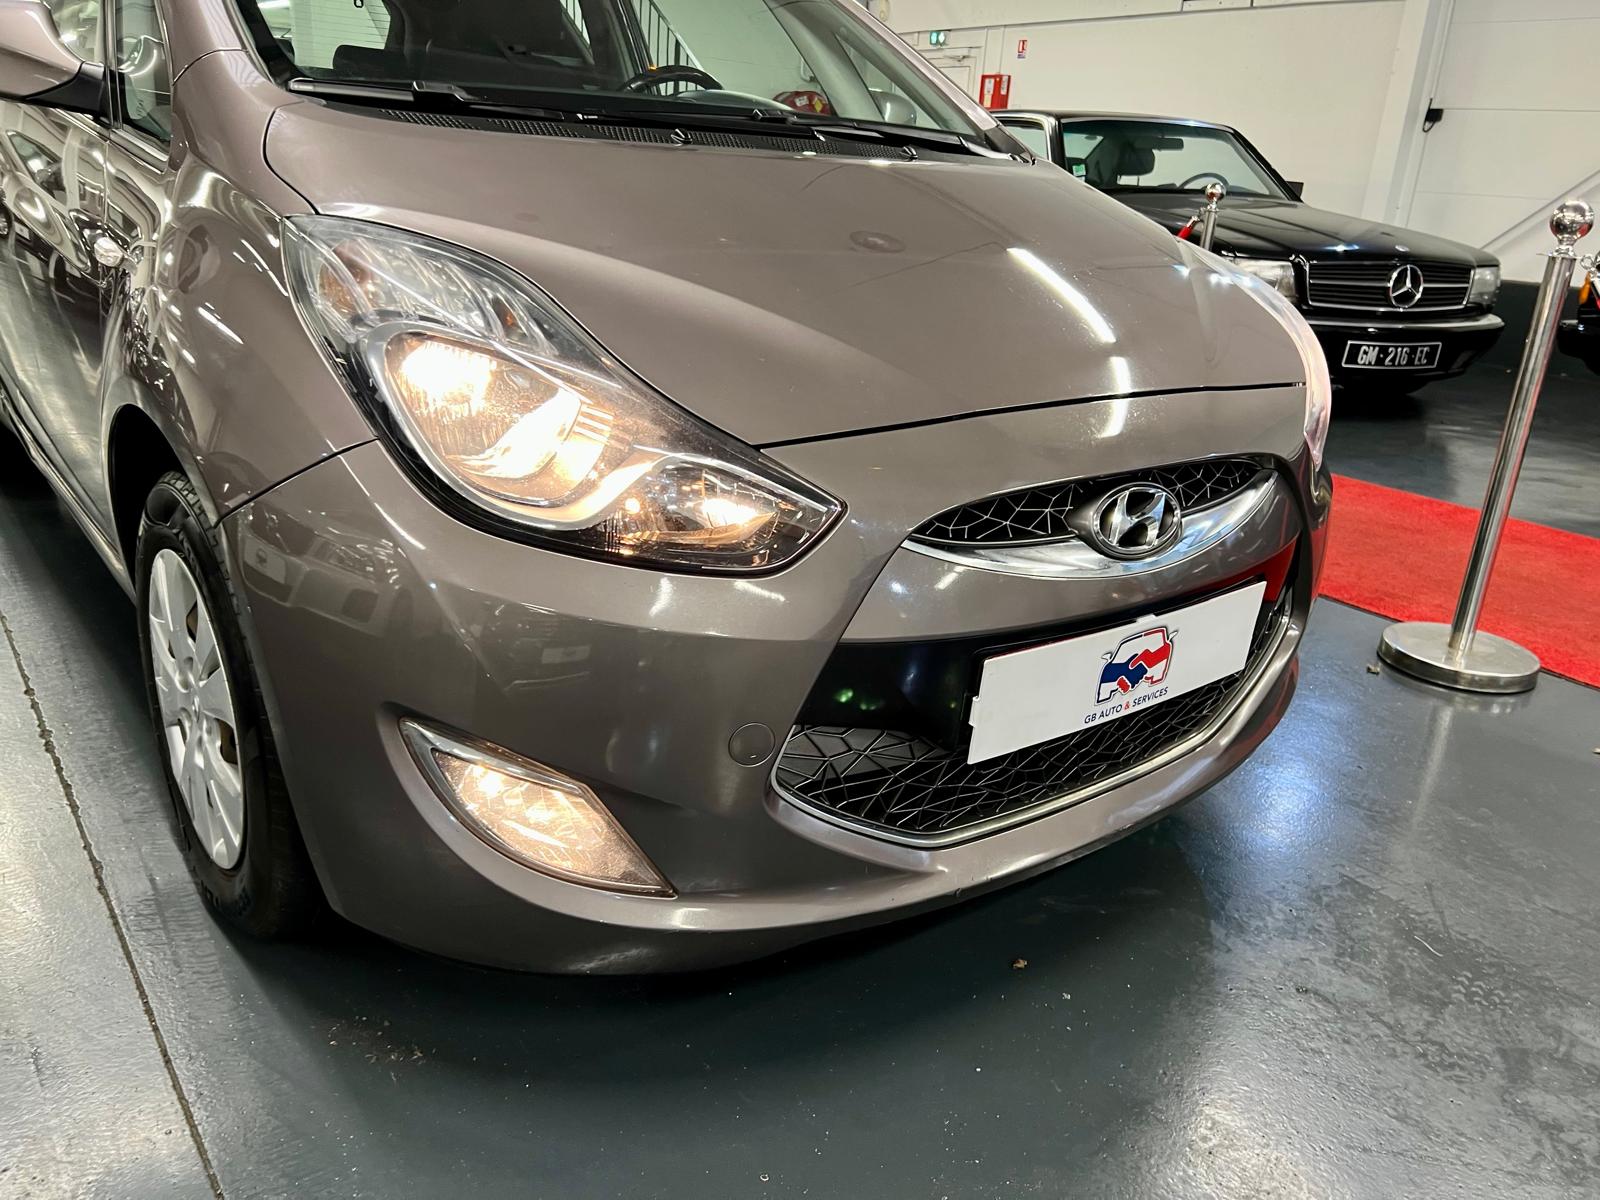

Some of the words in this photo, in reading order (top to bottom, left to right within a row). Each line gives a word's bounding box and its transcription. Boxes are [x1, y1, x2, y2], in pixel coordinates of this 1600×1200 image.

[1084, 713, 1097, 724] GB
[1098, 704, 1123, 719] AUTO
[1124, 700, 1131, 711] &
[1132, 686, 1168, 708] SERVICES
